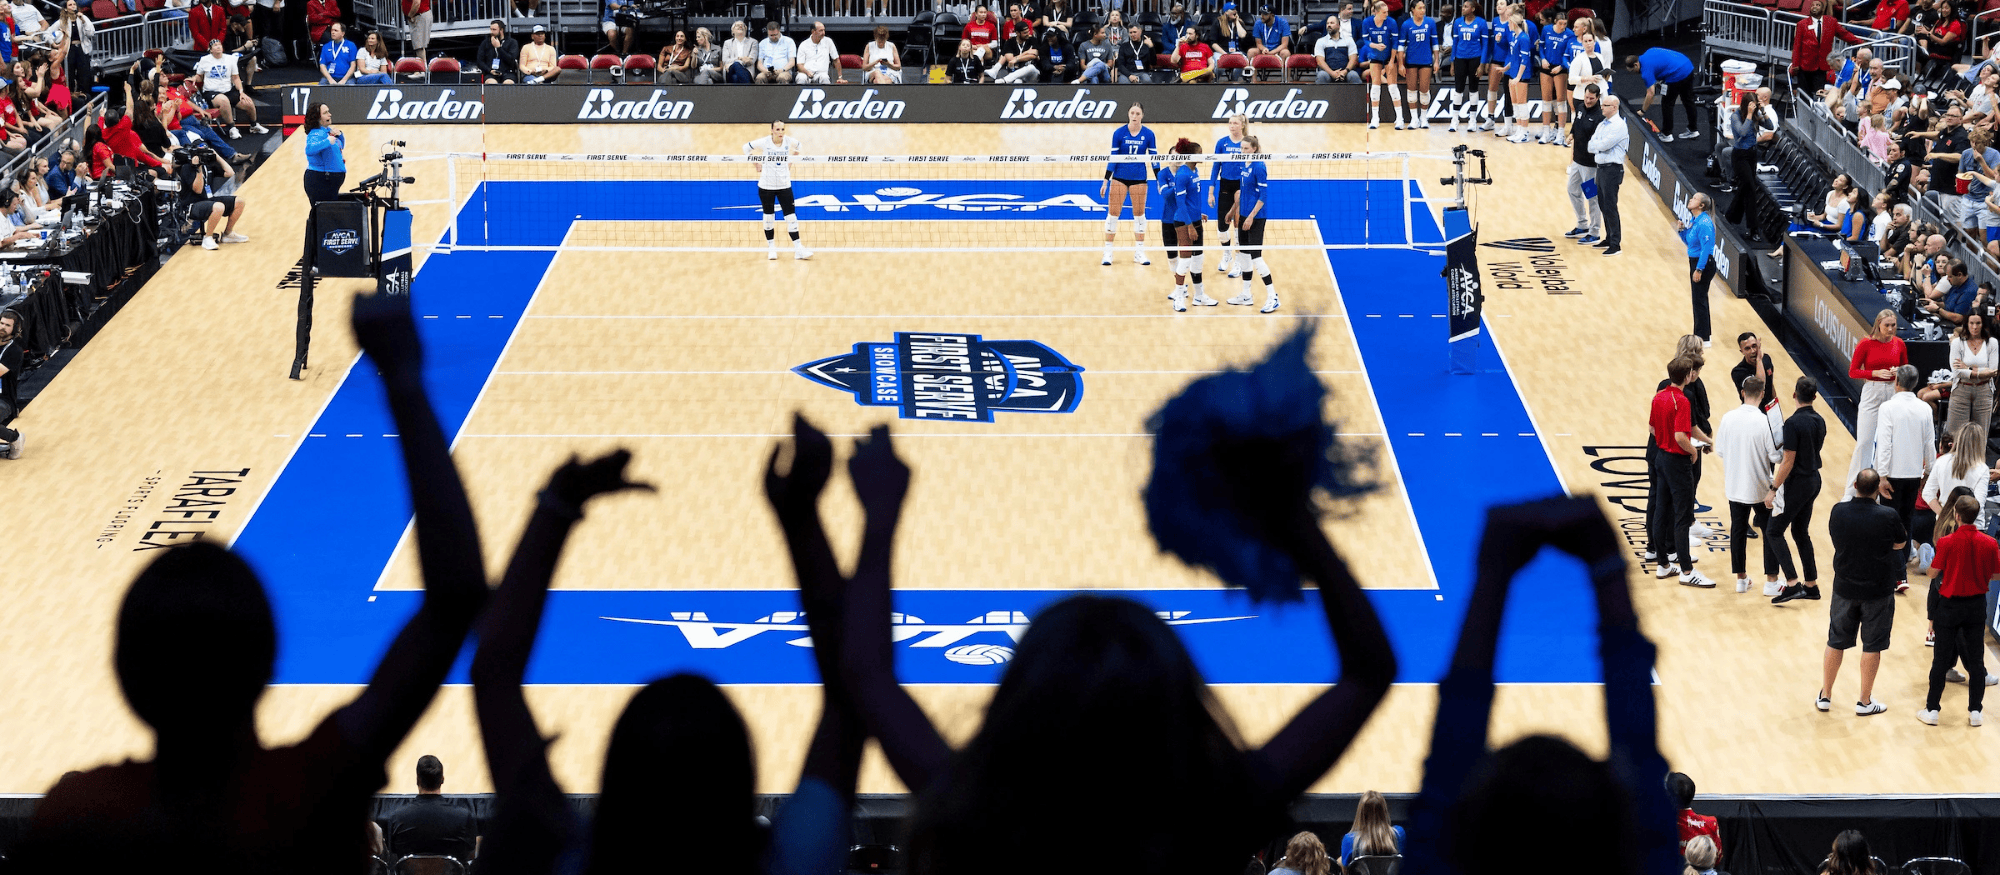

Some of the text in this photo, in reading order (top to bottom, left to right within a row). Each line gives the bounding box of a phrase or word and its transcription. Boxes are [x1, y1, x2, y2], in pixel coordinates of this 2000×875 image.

[290, 87, 311, 115] 17
[367, 89, 484, 120] Baden
[577, 89, 694, 120] Baden
[788, 88, 906, 119] Baden
[1000, 88, 1117, 119] Baden
[1212, 88, 1329, 119] Baden
[1128, 145, 1139, 154] 17
[755, 193, 1107, 212] AVCA
[1527, 253, 1583, 295] Volleyball
[1713, 238, 1729, 280] aden
[1486, 262, 1533, 289] World
[1459, 267, 1476, 316] AVCA
[873, 347, 898, 402] SHOWCASE
[909, 334, 978, 419] FIRST SERVE
[981, 351, 1048, 399] AVCA
[96, 476, 161, 543] SPORTS FLOORING
